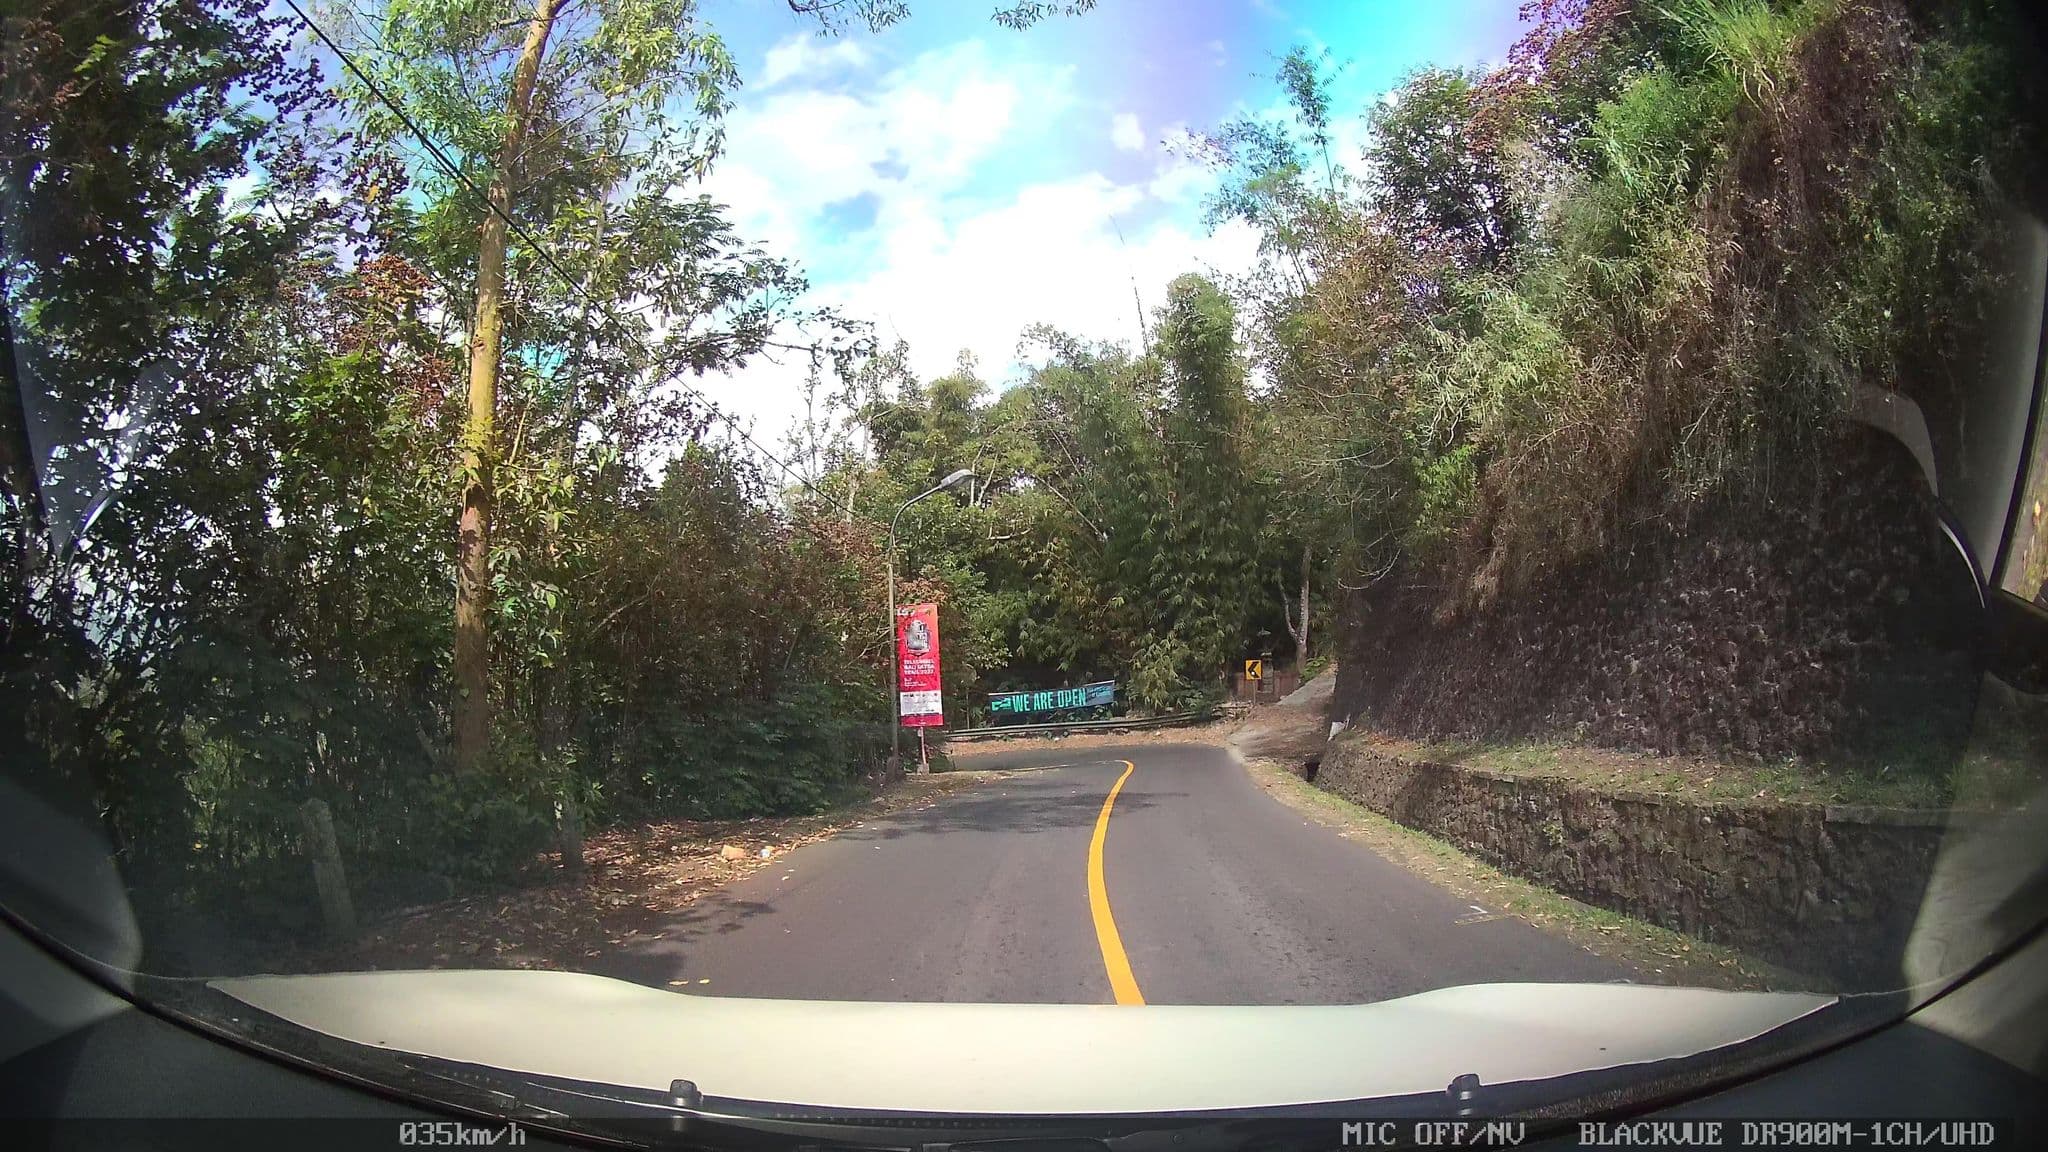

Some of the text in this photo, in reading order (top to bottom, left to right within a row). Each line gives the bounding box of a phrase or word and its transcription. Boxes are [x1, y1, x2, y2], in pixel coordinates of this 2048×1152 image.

[1012, 694, 1030, 713] WE
[1033, 691, 1054, 711] ARE
[1057, 687, 1087, 709] OPEN
